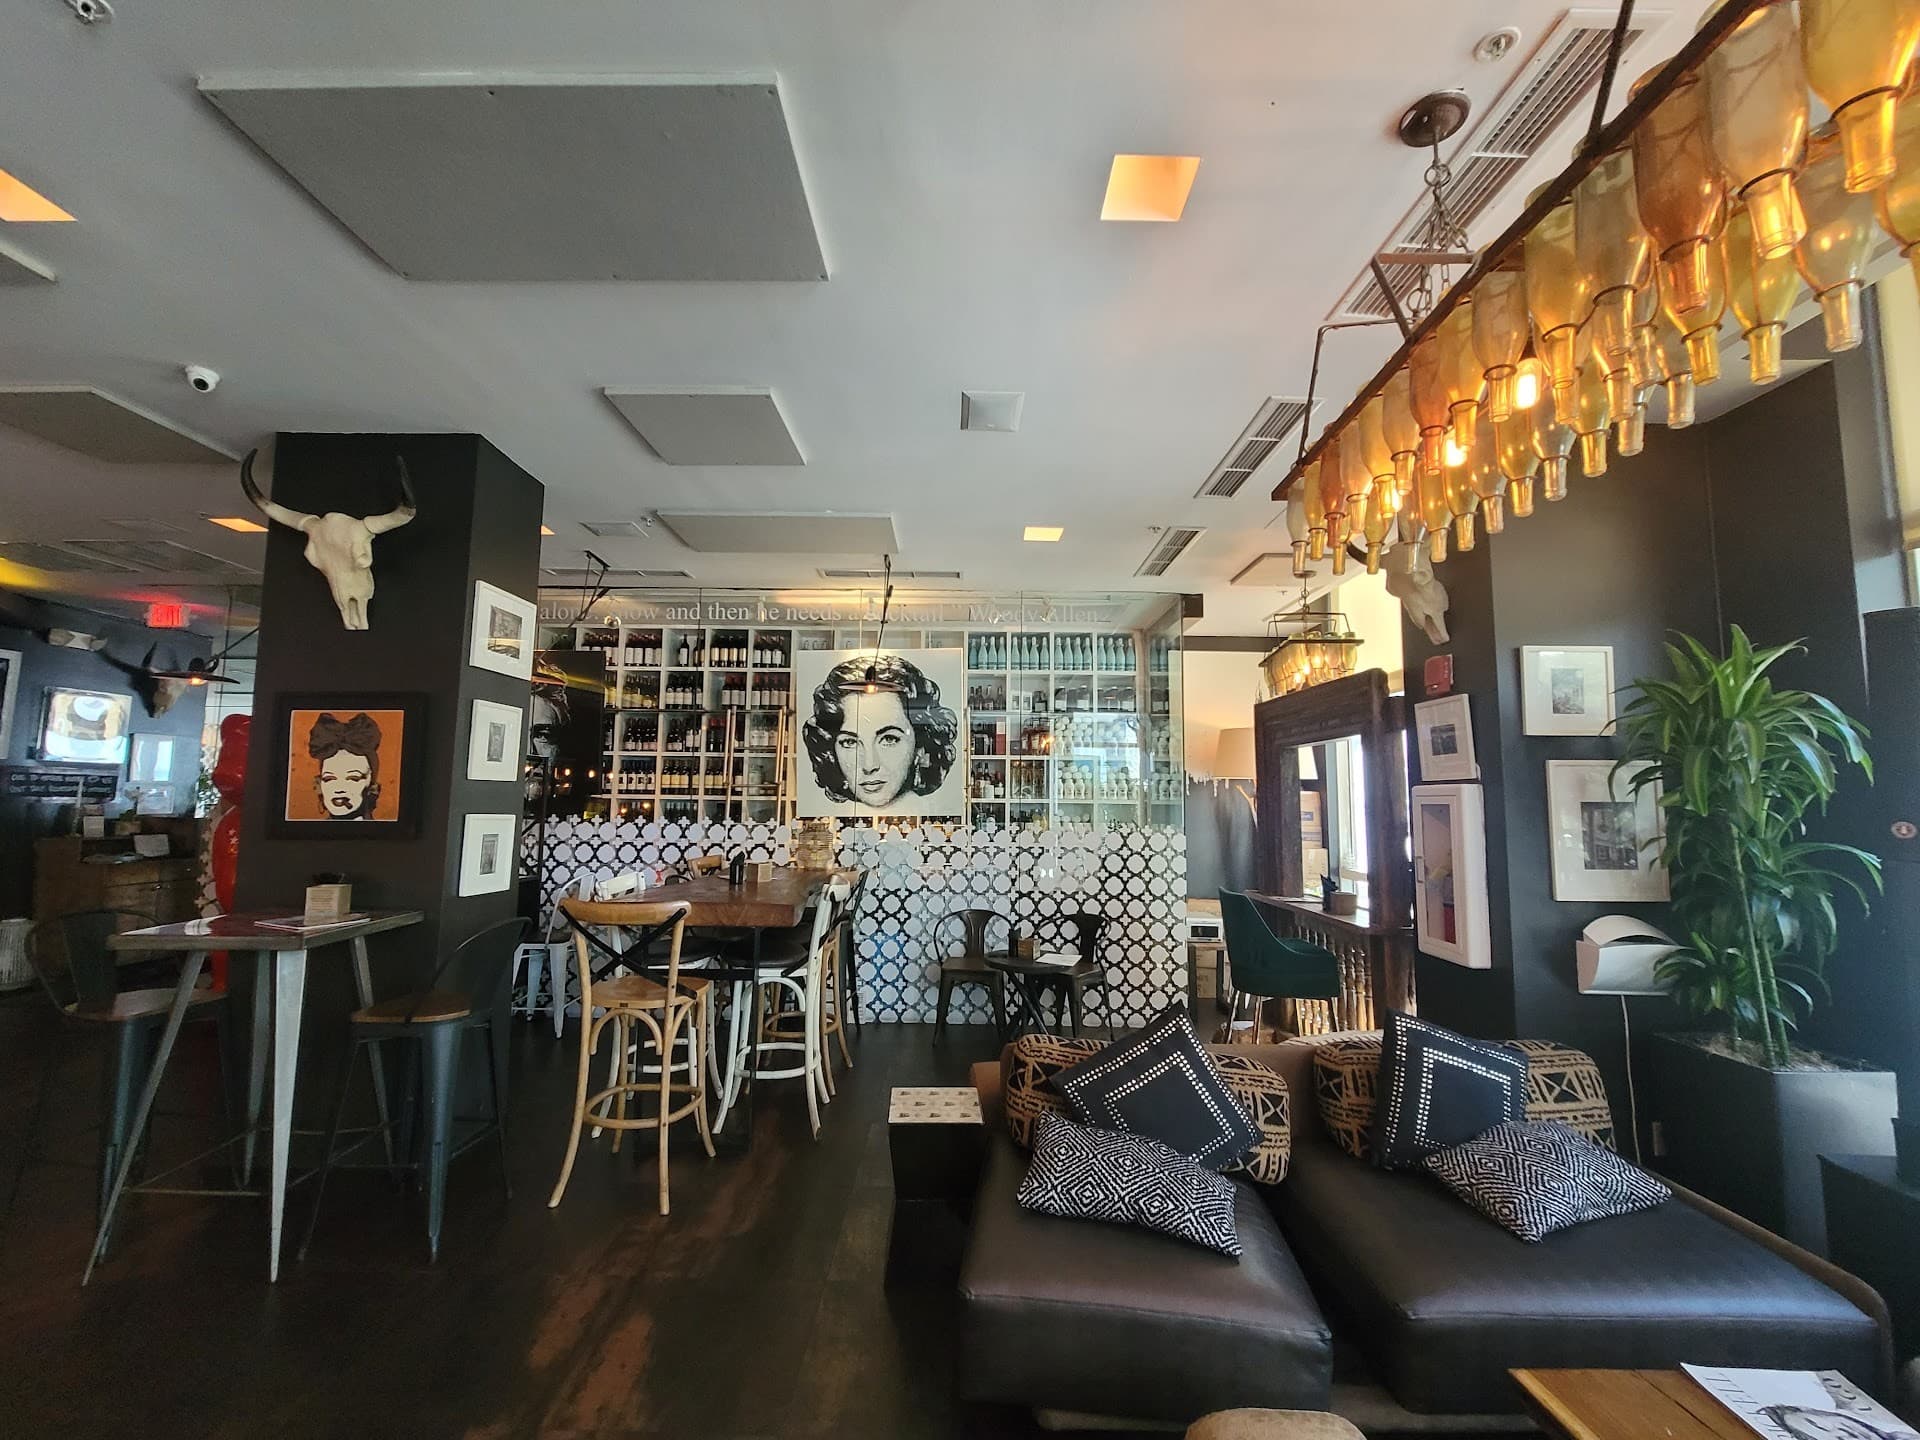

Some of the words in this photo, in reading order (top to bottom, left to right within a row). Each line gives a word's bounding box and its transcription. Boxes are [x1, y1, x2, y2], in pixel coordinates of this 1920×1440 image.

[666, 602, 701, 620] and
[708, 602, 750, 620] then
[757, 602, 780, 621] he
[786, 602, 841, 622] needs
[848, 611, 859, 622] a
